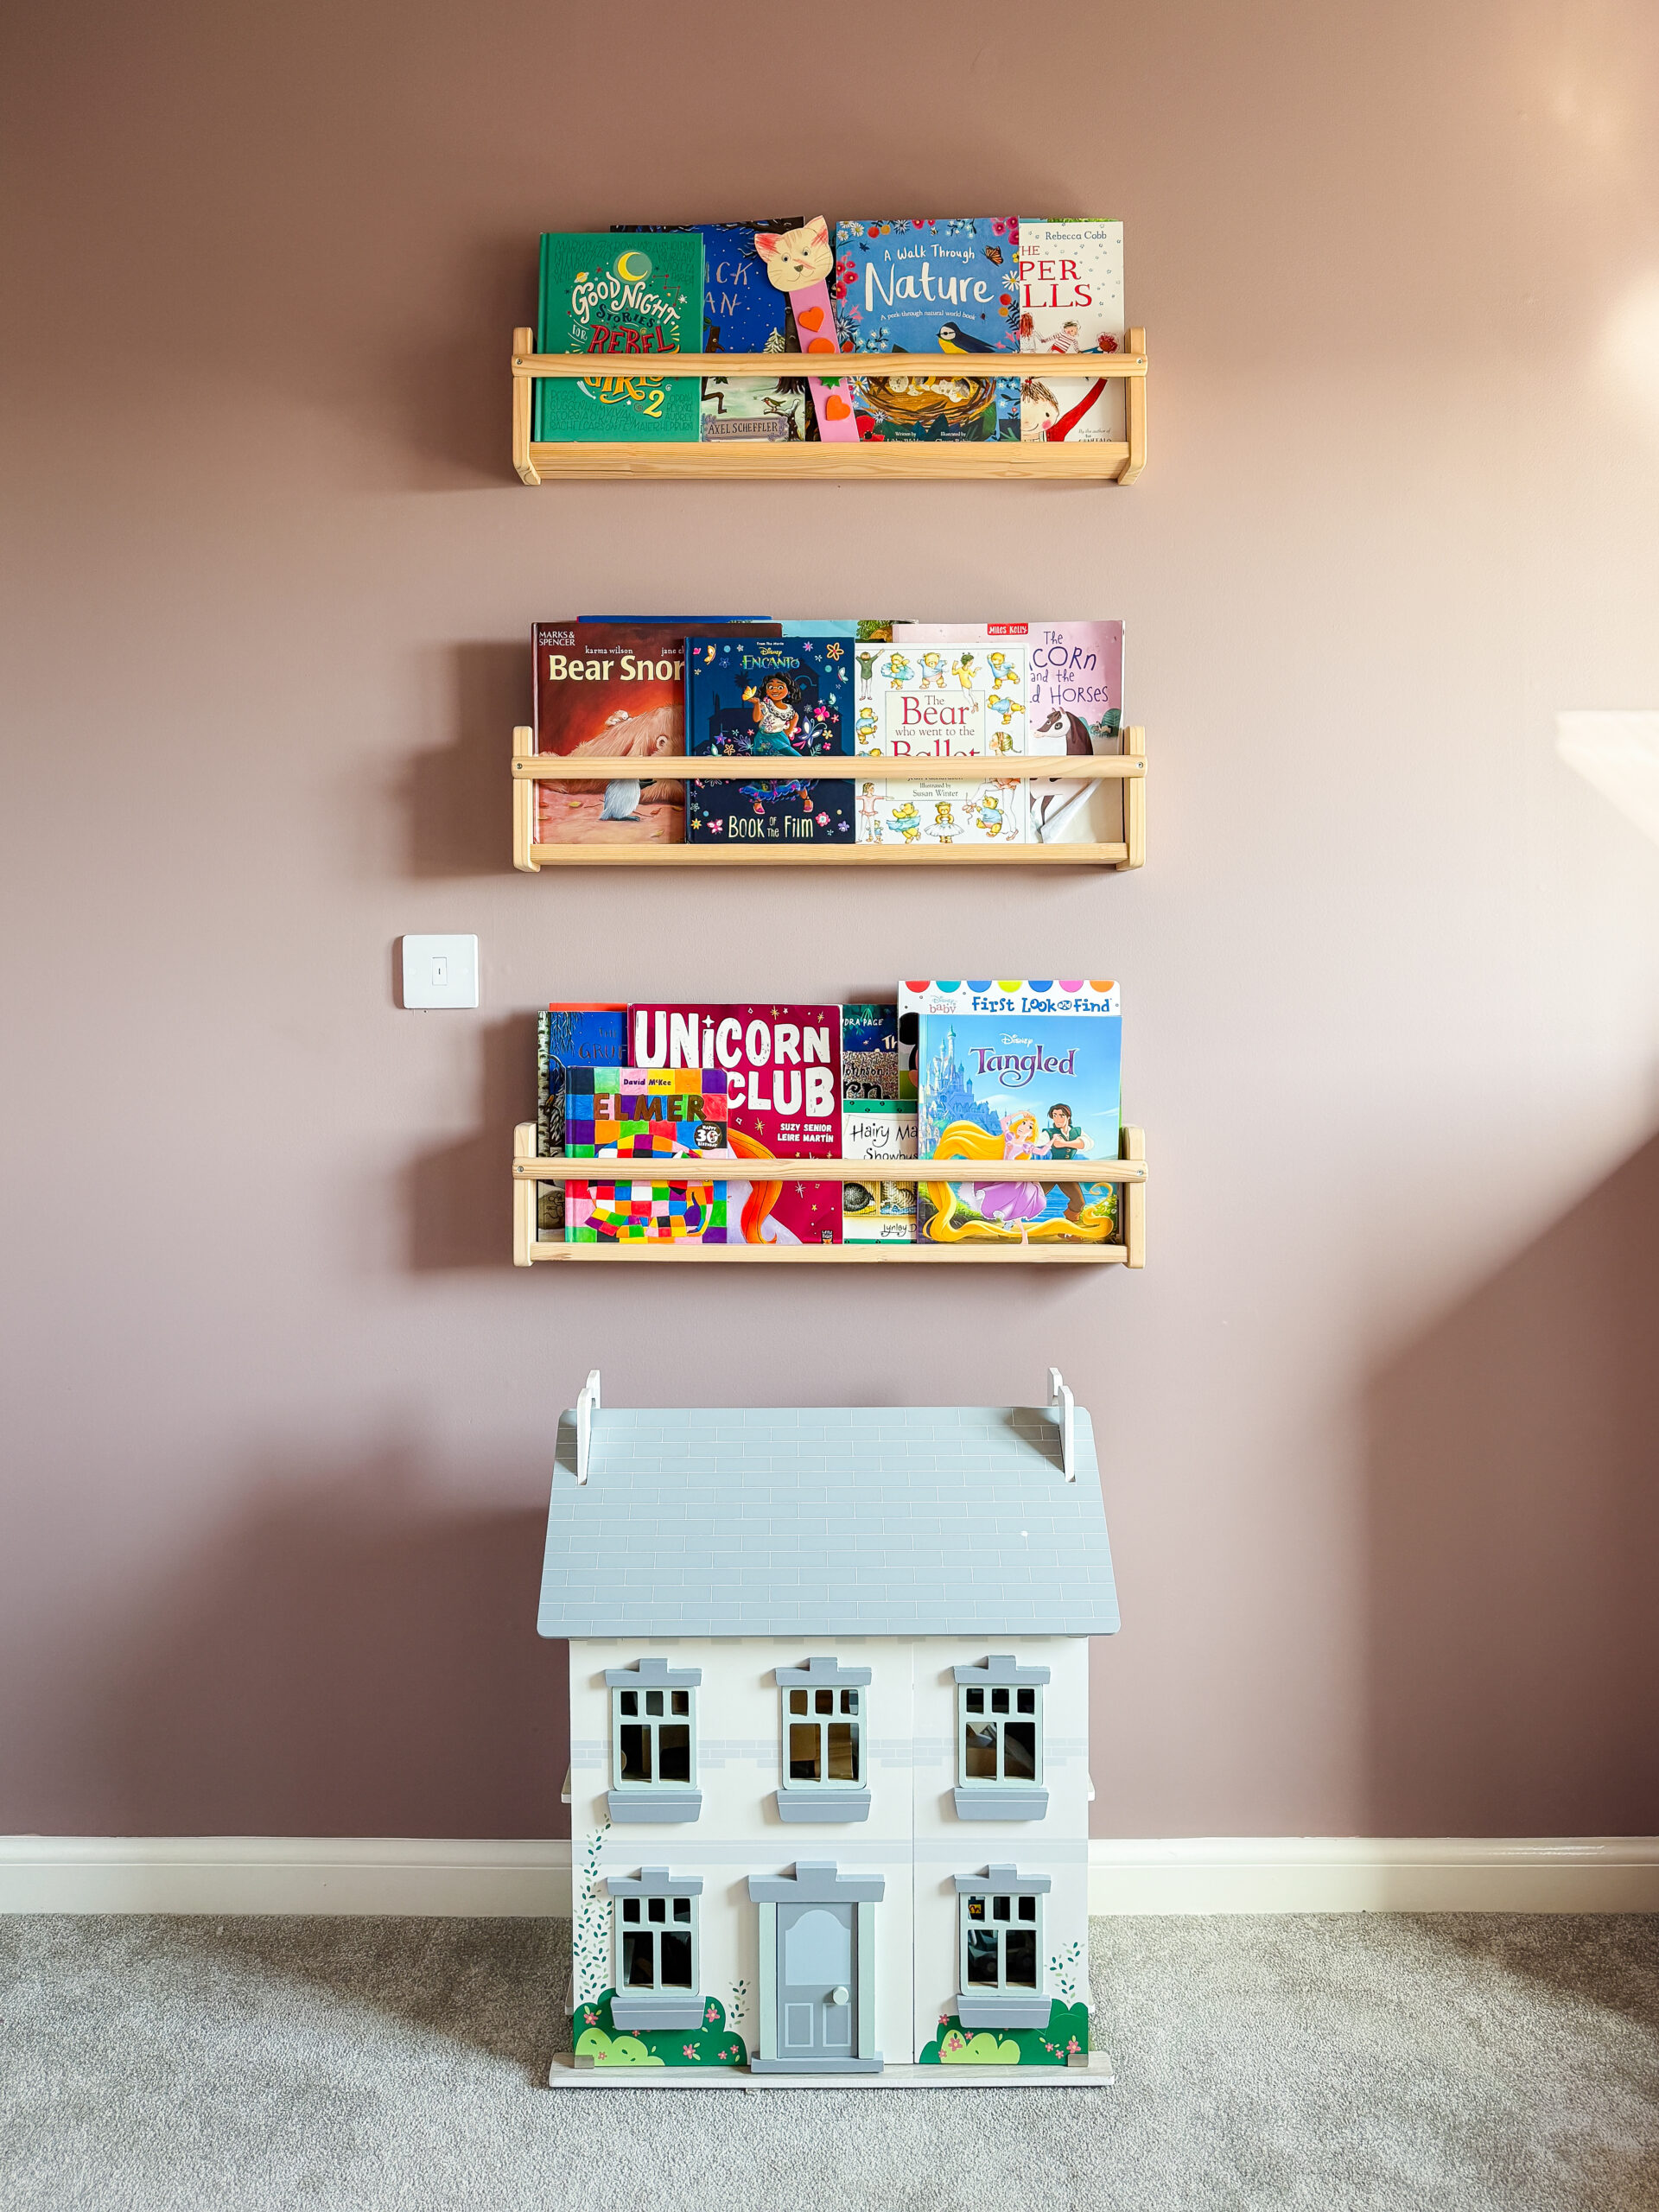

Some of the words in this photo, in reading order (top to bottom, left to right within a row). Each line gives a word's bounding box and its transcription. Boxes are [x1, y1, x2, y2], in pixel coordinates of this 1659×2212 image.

[1084, 231, 1107, 239] Cobb
[884, 249, 892, 261] A
[897, 244, 927, 258] Walk
[930, 244, 976, 264] Through
[1020, 245, 1040, 256] HE
[1020, 259, 1082, 281] PER
[865, 262, 995, 312] Nature
[572, 271, 620, 324] GOOD
[611, 282, 681, 324] NIGHT
[1022, 283, 1092, 308] LLS
[596, 304, 656, 328] STORIES
[962, 312, 976, 321] book
[572, 324, 588, 340] FOR
[588, 324, 675, 353] REBEL
[643, 390, 665, 418] 2
[708, 423, 731, 434] AXEL
[732, 422, 778, 434] SCHEFFLER
[538, 631, 568, 639] MARKS
[1043, 631, 1064, 645] The
[585, 645, 607, 654] karma
[608, 645, 633, 654] wilson
[661, 647, 677, 657] jane
[758, 646, 783, 657] Disney
[549, 654, 614, 681] Bear
[620, 655, 685, 681] Snor
[742, 655, 800, 670] ENCANTO
[1031, 669, 1049, 683] and
[1056, 669, 1075, 683] the
[924, 695, 944, 705] The
[901, 696, 970, 725] Bear
[895, 728, 916, 736] who
[918, 728, 944, 736] went
[945, 728, 957, 736] to
[959, 728, 976, 736] the
[931, 995, 957, 1005] Disney
[1021, 997, 1057, 1013] Look
[929, 1003, 957, 1014] baby
[999, 1033, 1033, 1048] Disney
[968, 1044, 1080, 1089] Tangled
[728, 1066, 836, 1117] CLUB
[593, 1093, 708, 1122] ELMER
[780, 1123, 801, 1132] SUZY
[803, 1123, 832, 1132] SENIOR
[849, 1122, 890, 1148] Hairy
[895, 1124, 918, 1141] Ma
[696, 1128, 719, 1143] 30
[777, 1133, 800, 1142] LEIRE
